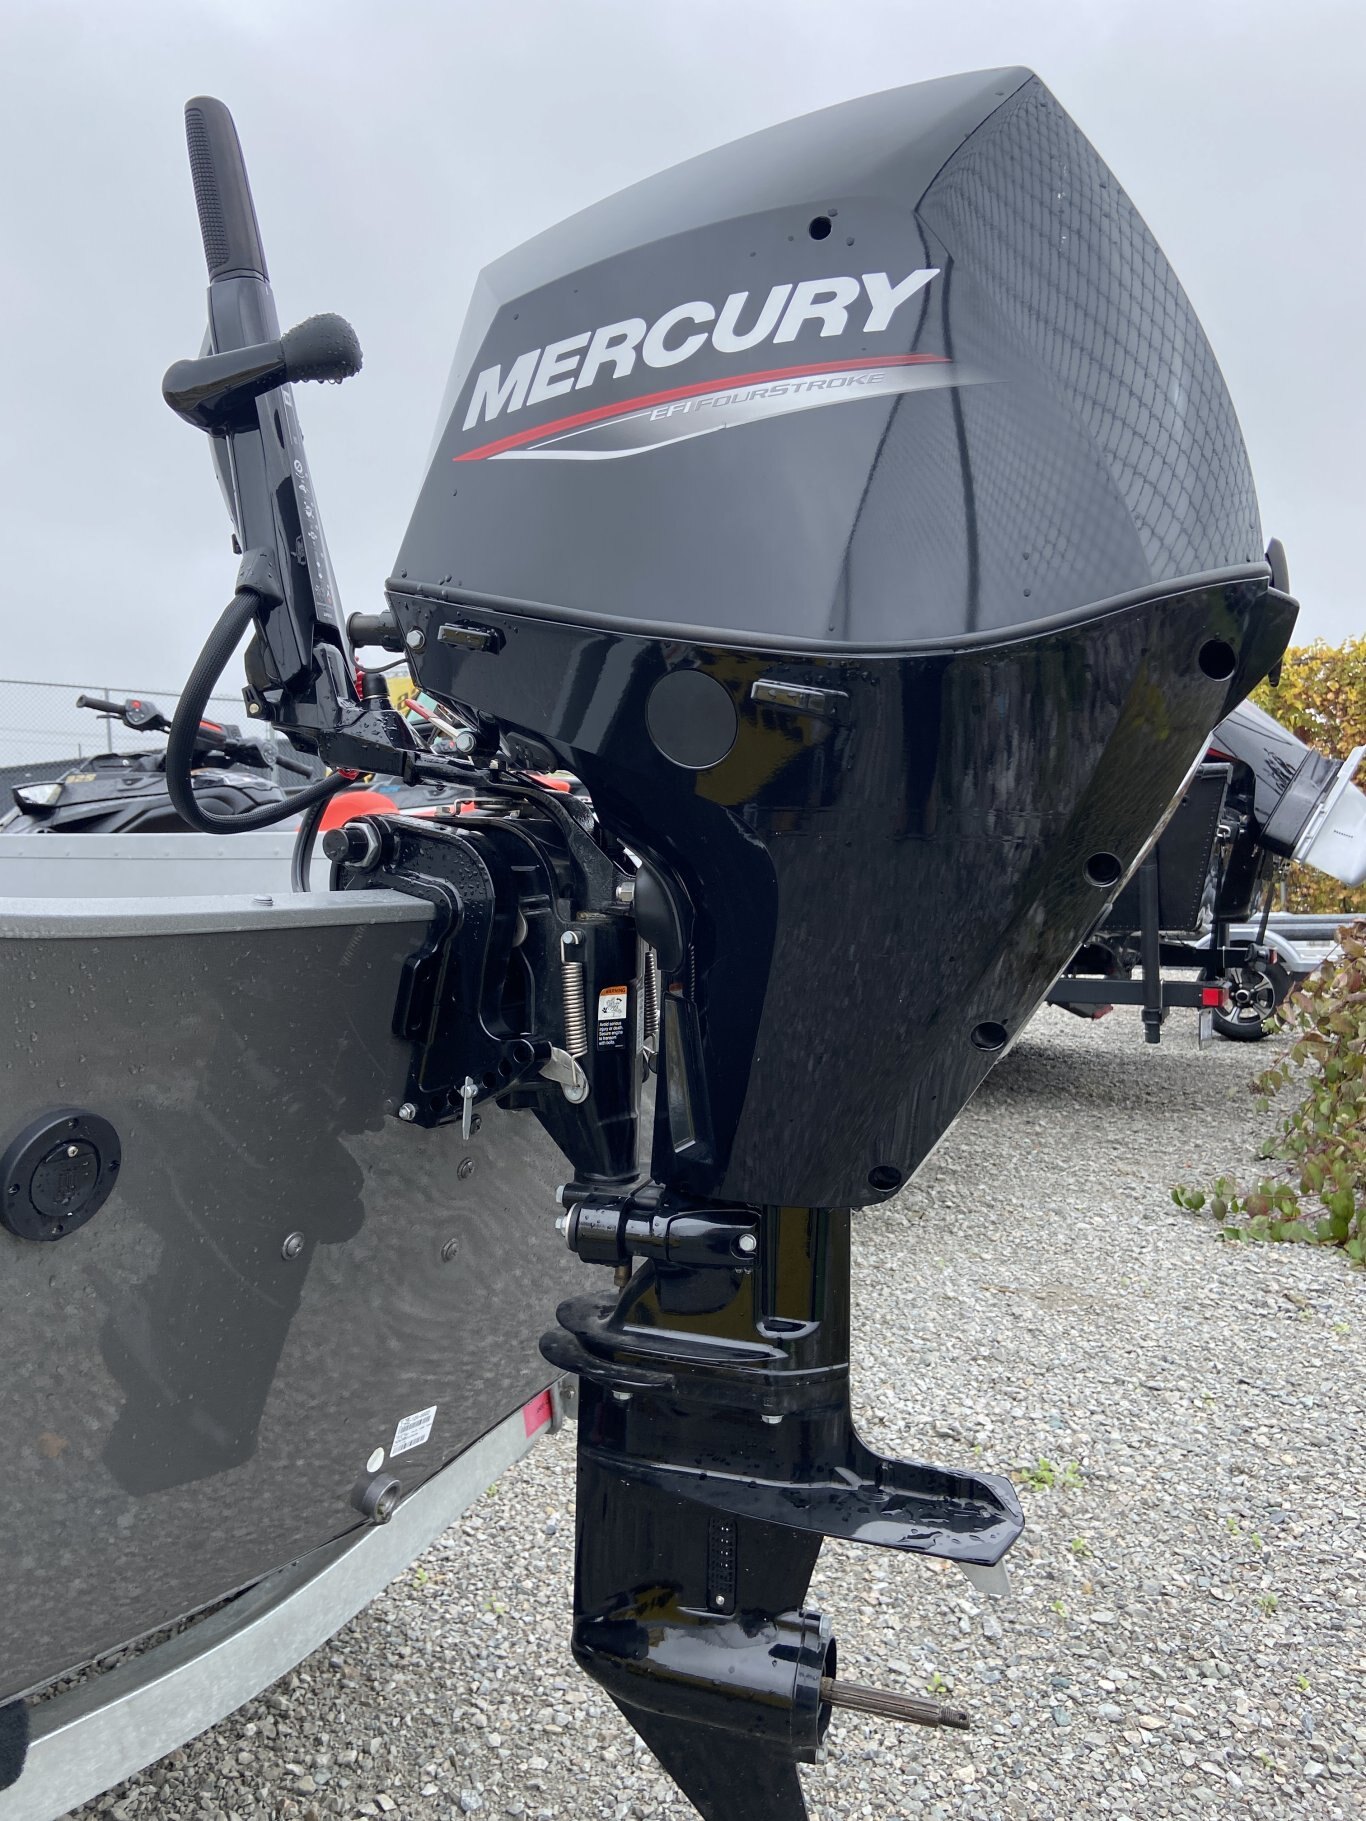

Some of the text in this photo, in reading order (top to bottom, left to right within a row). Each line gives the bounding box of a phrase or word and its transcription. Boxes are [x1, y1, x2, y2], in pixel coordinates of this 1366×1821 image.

[462, 268, 940, 431] MERCURY
[649, 373, 886, 421] EFI FOURSTROKE
